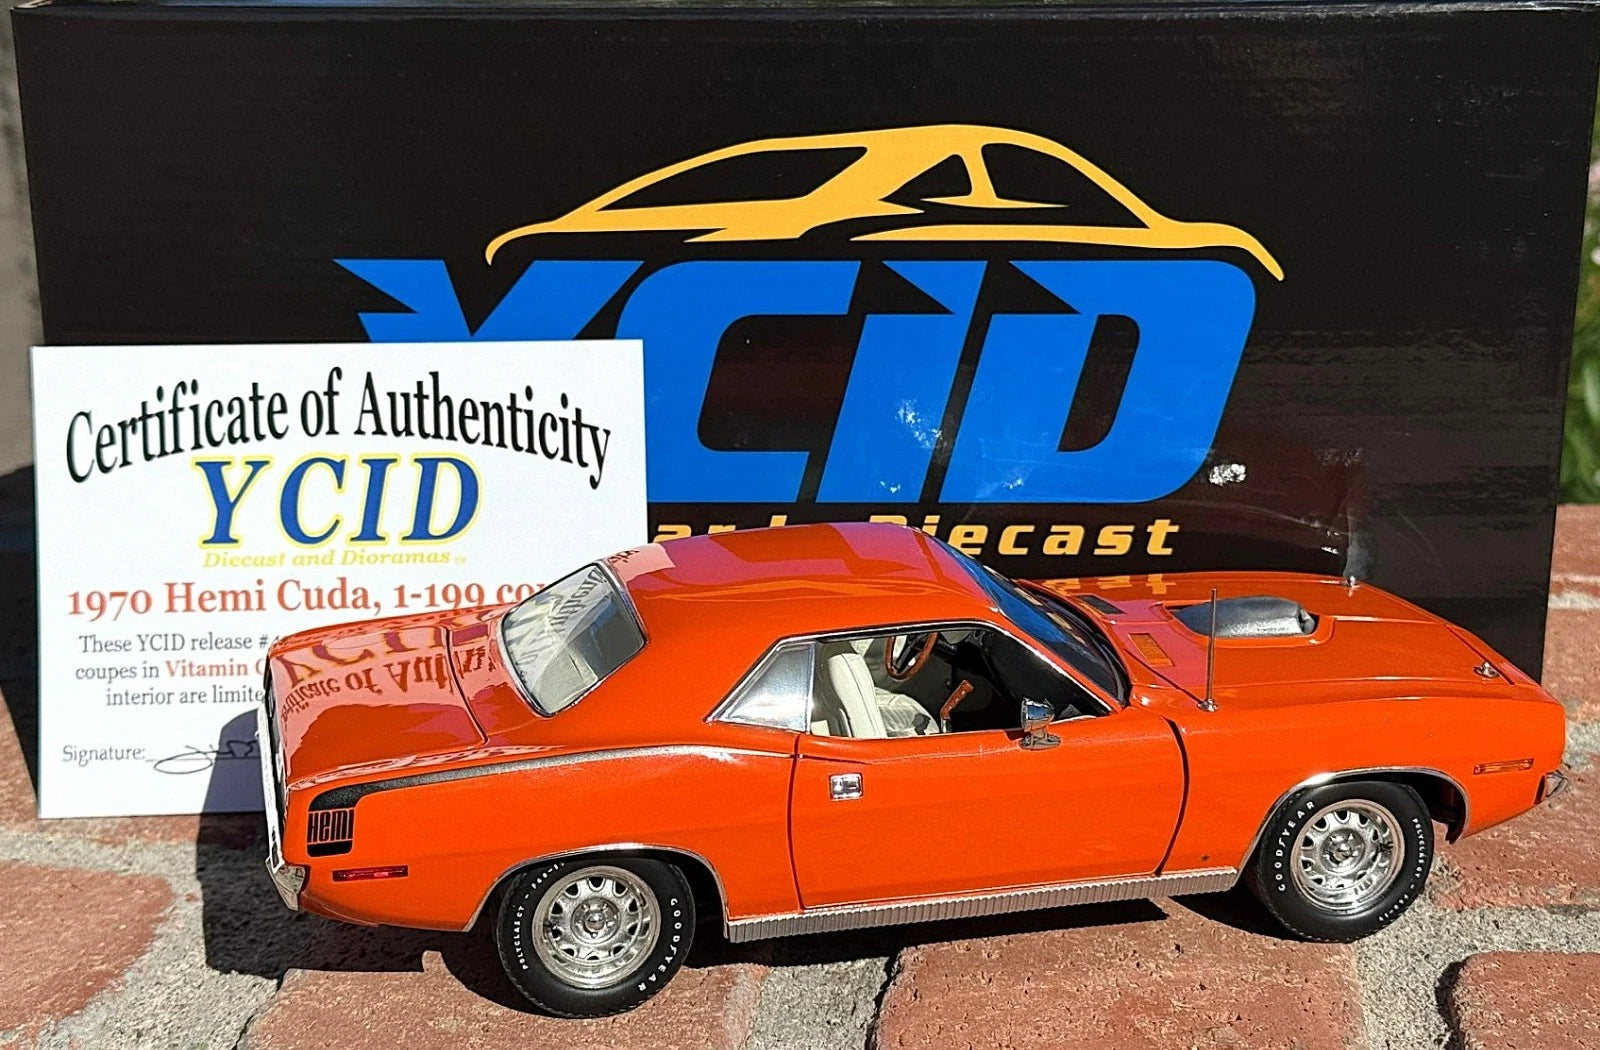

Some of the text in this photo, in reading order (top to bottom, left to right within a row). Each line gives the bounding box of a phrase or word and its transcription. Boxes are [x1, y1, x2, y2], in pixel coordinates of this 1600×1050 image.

[66, 366, 612, 490] Certificate of Authenticity
[193, 455, 480, 544] YCID
[202, 548, 452, 569] Diecast and Dioramas
[67, 589, 153, 623] 1970
[164, 578, 268, 614] Hemi
[276, 577, 382, 616] Cuda,
[393, 583, 485, 611] 1-199
[78, 634, 133, 653] These
[136, 633, 185, 652] YCID
[190, 631, 253, 651] release
[75, 665, 138, 684] coupes
[142, 660, 160, 679] in
[165, 657, 249, 678] Vitamin
[105, 686, 172, 706] interior
[178, 691, 208, 705] are
[61, 744, 146, 767] Signature:
[1274, 801, 1316, 892] GOODYEAR
[637, 897, 683, 992] GOODYEAR
